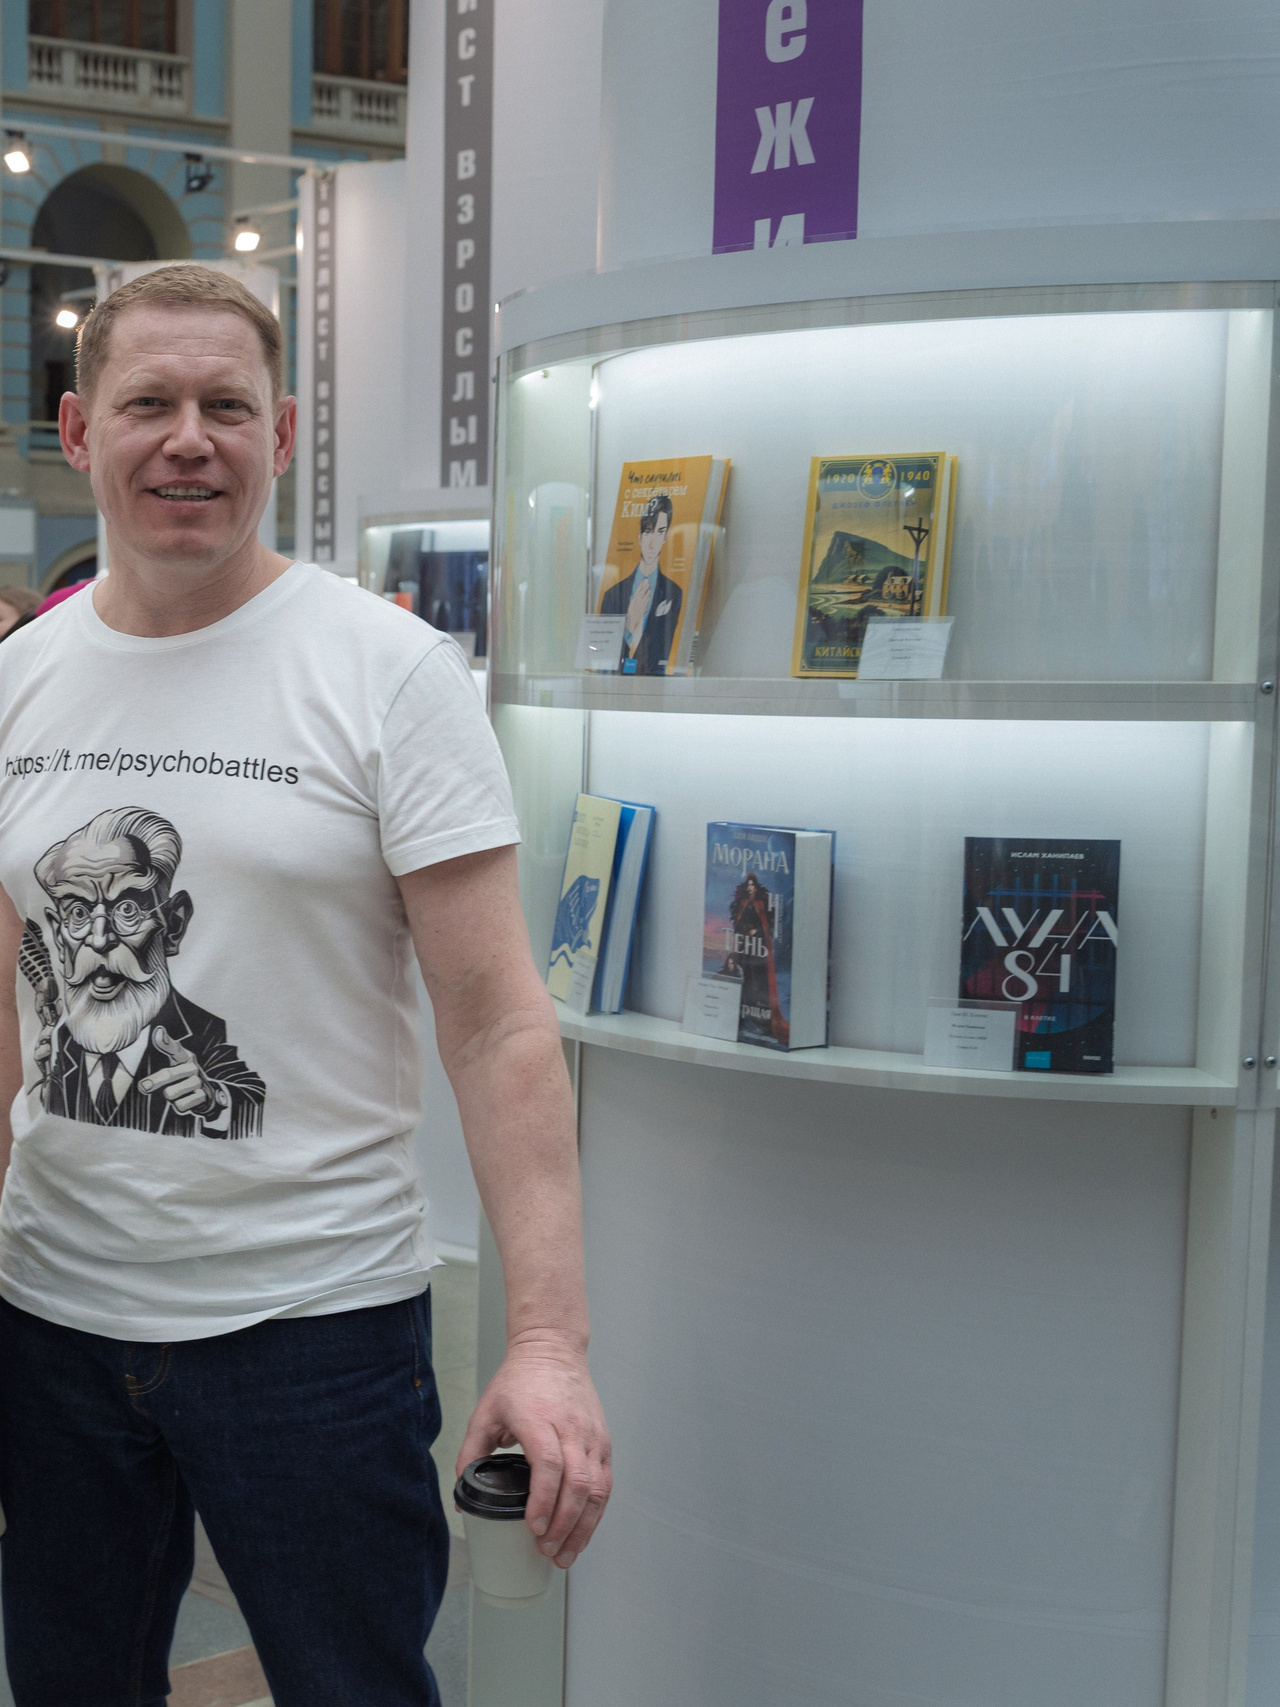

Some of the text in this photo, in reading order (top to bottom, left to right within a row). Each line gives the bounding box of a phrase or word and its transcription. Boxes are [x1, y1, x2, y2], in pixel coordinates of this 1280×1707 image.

[450, 149, 477, 488] ВЗРОСЛЫМ
[825, 473, 855, 484] 1920
[900, 470, 931, 481] 1940
[620, 498, 658, 518] Ким?
[713, 843, 790, 878] МОРАНА
[1010, 851, 1040, 859] ИСЛАМ
[722, 927, 768, 958] ТЕНЬ
[1001, 943, 1071, 1001] 84
